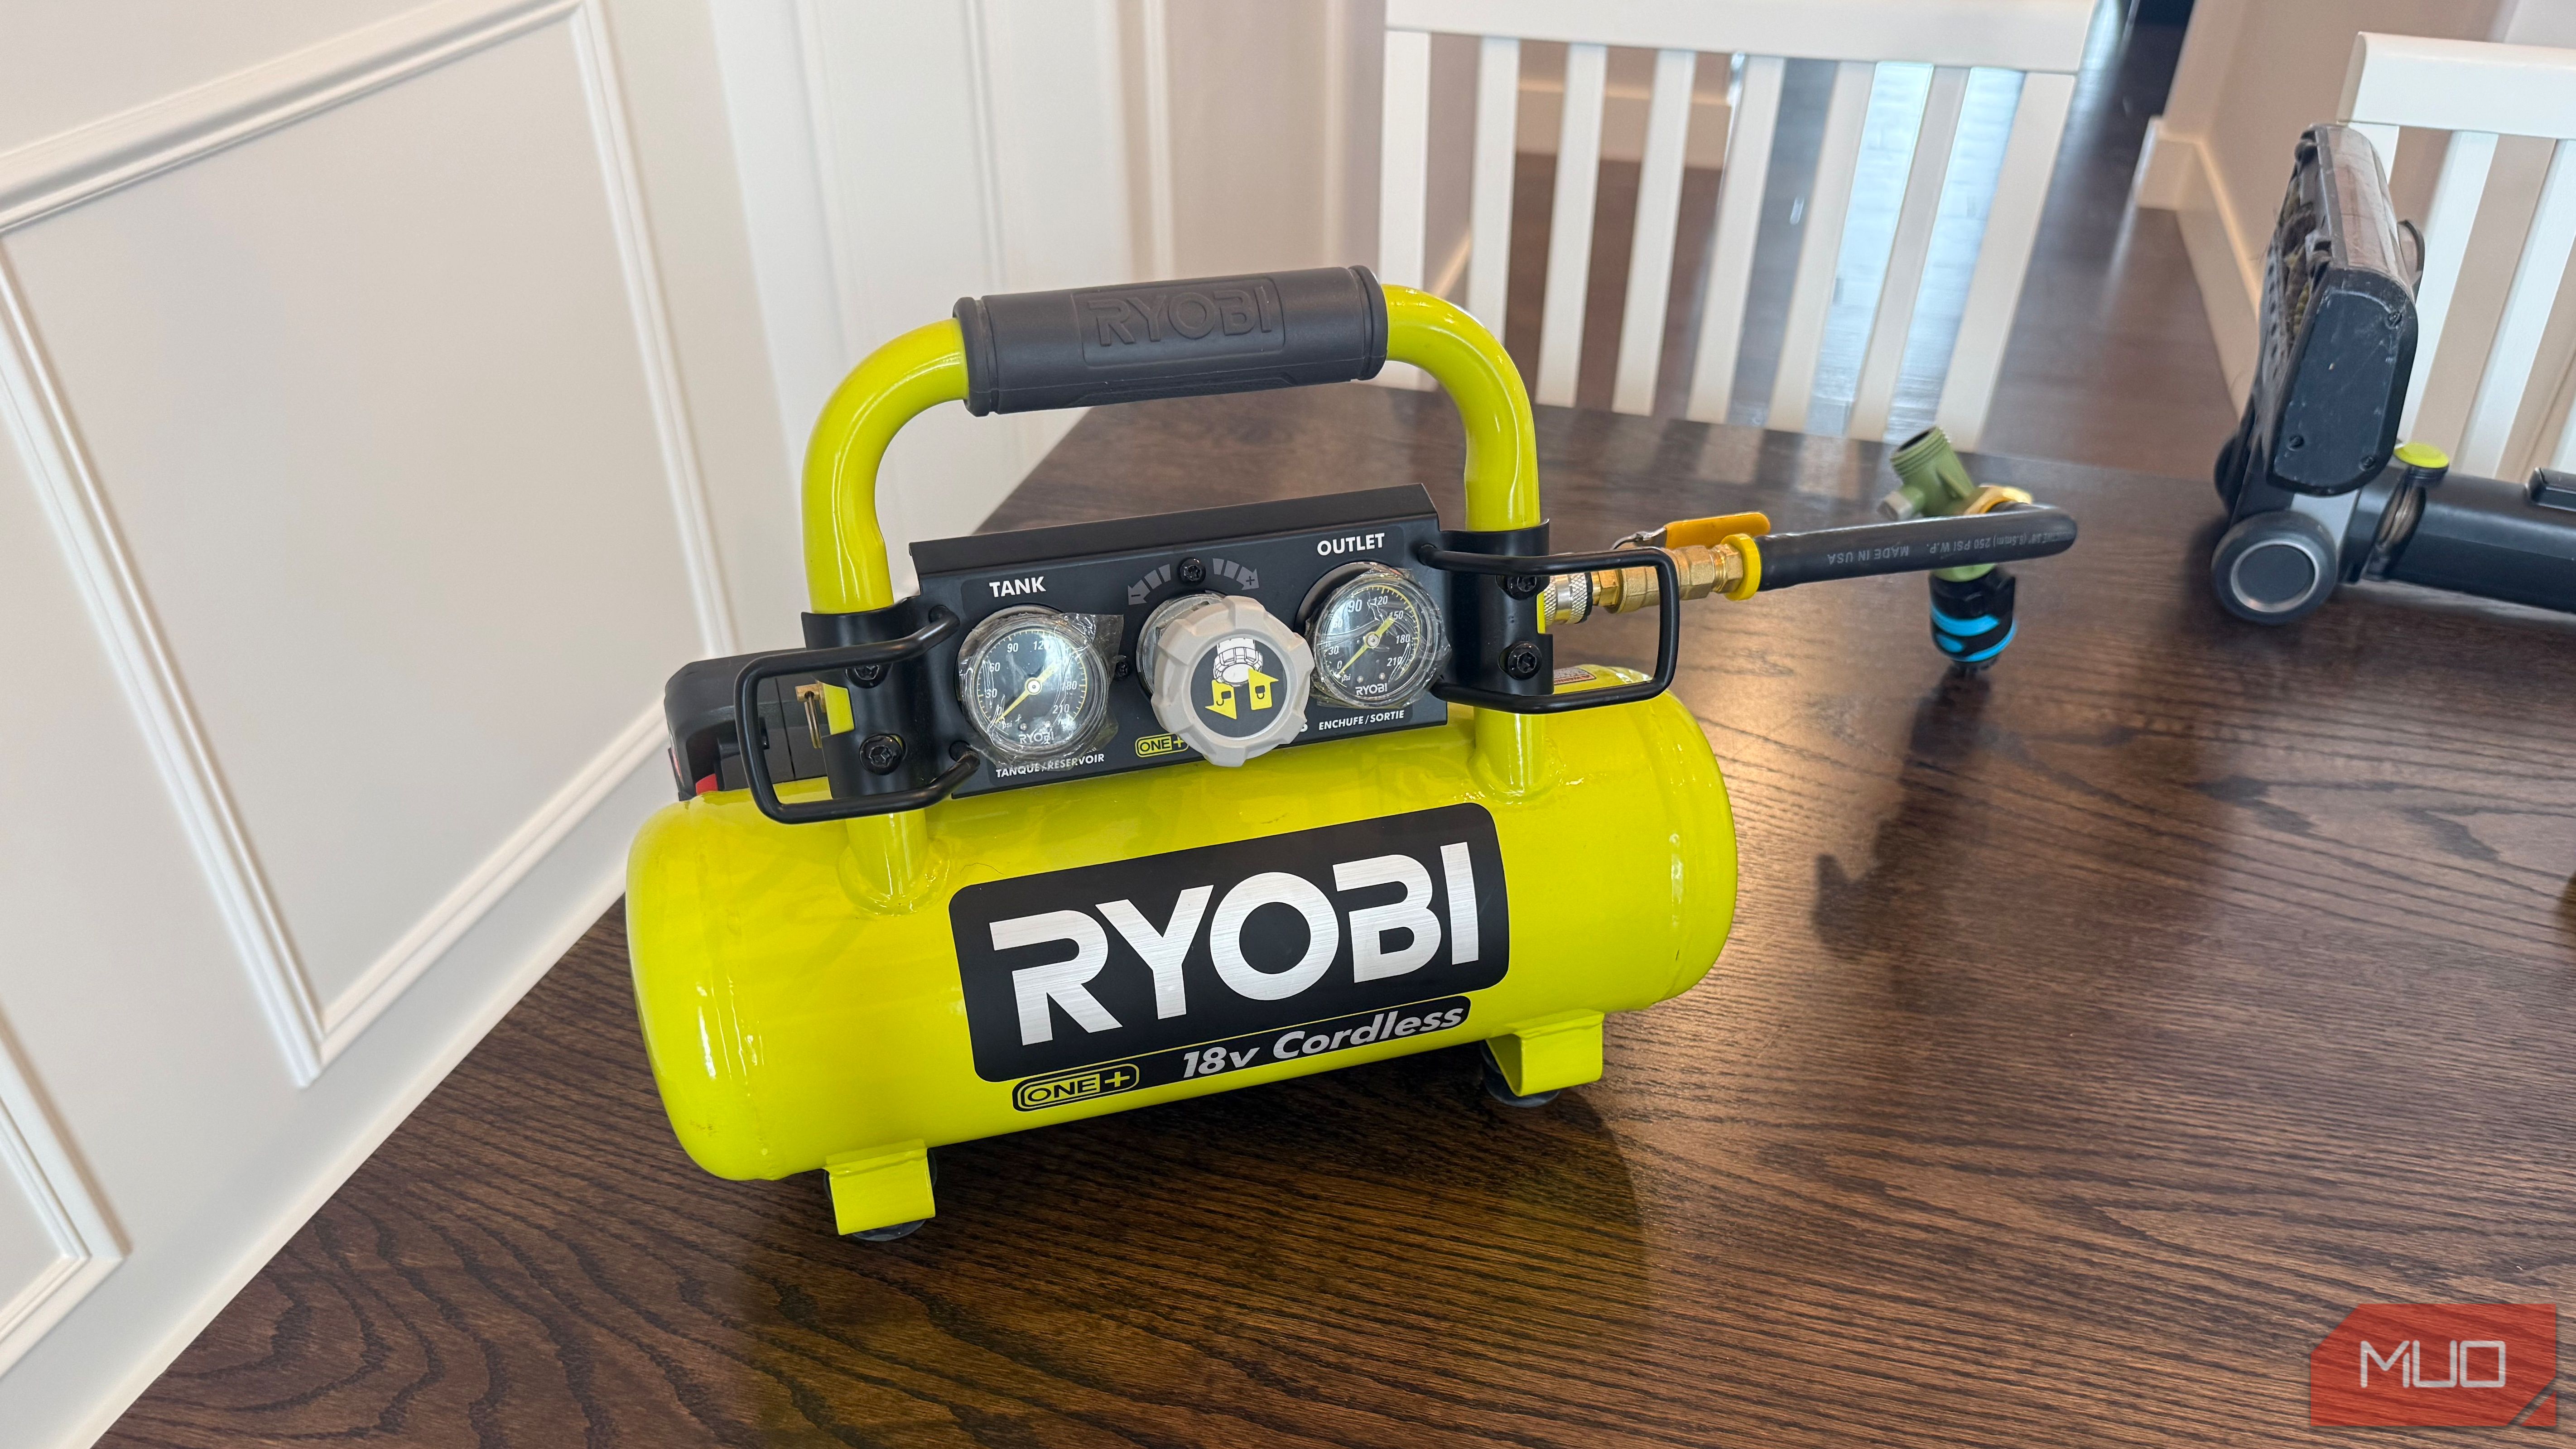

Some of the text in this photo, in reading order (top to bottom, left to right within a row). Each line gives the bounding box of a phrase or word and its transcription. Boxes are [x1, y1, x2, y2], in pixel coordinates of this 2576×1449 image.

[1088, 286, 1272, 347] RYOBI
[1317, 533, 1385, 556] OUTLET
[1954, 540, 1970, 552] PSI
[1974, 538, 1991, 549] 250
[1827, 546, 1909, 565] MADE IN USA
[989, 576, 1046, 597] TANK
[1348, 599, 1363, 612] 90
[1374, 596, 1388, 605] 120
[1396, 634, 1410, 644] 180
[1007, 643, 1019, 652] 90
[1329, 646, 1339, 655] 30
[989, 662, 1000, 672] 60
[1337, 660, 1343, 669] 0
[1387, 656, 1402, 667] 210
[985, 688, 997, 698] 30
[1355, 683, 1387, 695] RYOBI
[1053, 705, 1069, 714] 210
[1019, 731, 1054, 744] RYOBI
[989, 842, 1480, 1046] RYOBI
[1183, 1046, 1261, 1078] 18v
[1273, 1005, 1464, 1060] Cordless
